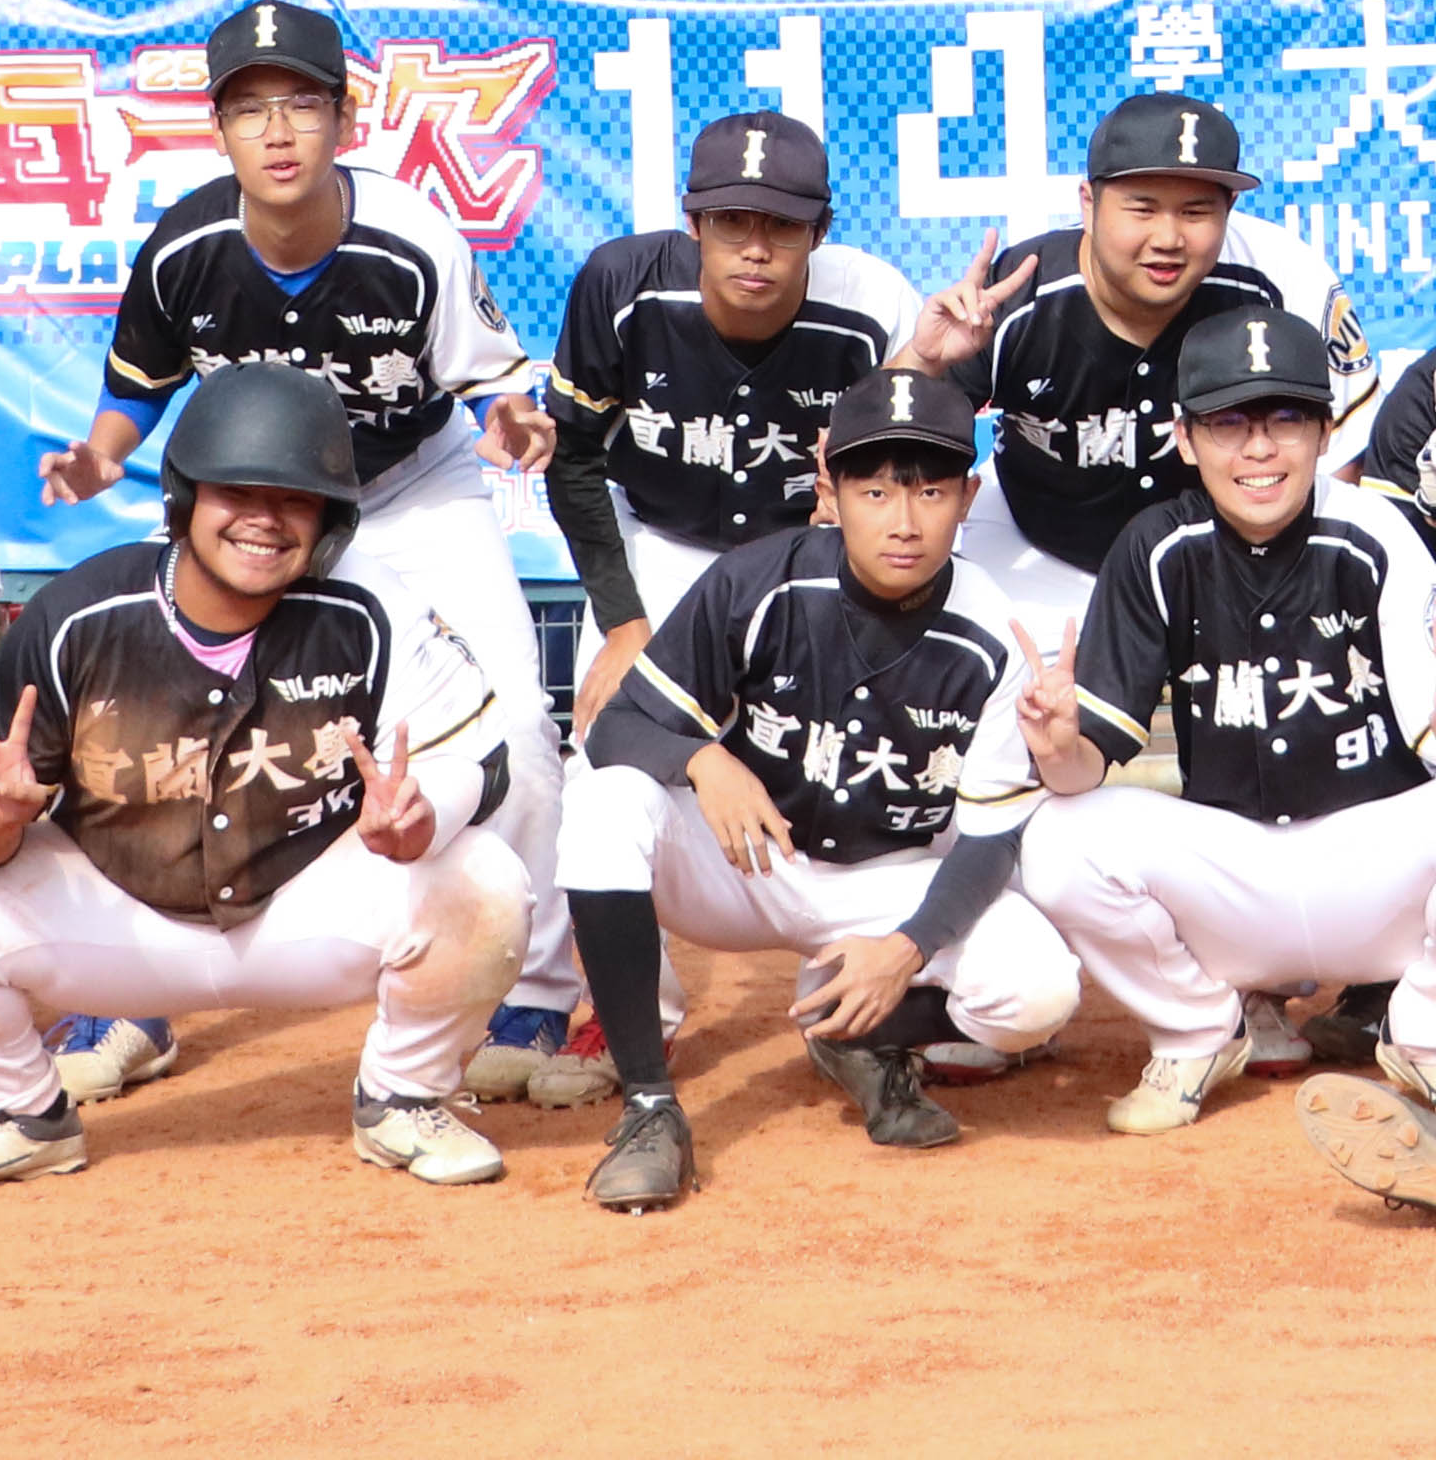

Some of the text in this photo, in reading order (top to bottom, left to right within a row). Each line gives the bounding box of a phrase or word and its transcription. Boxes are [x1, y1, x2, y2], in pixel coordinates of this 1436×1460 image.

[594, 11, 1088, 237] 114
[626, 398, 826, 475] 宜蘭大
